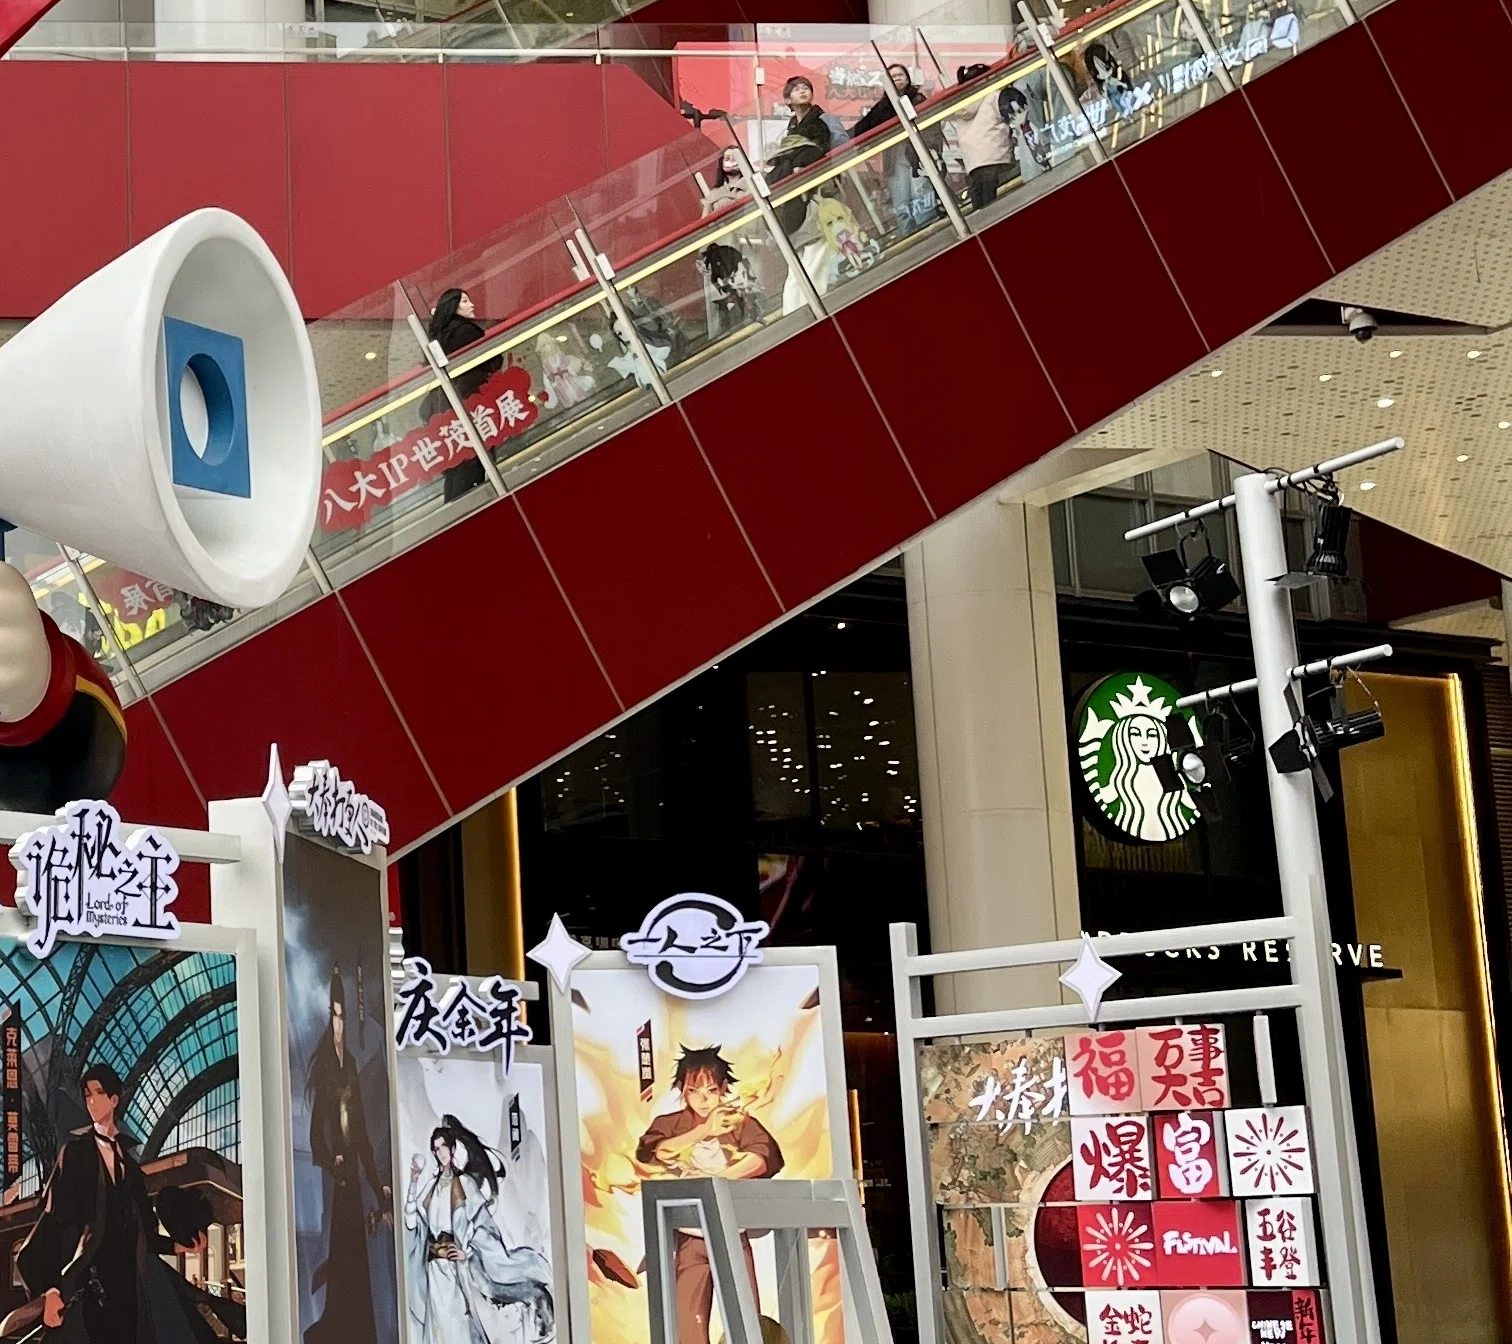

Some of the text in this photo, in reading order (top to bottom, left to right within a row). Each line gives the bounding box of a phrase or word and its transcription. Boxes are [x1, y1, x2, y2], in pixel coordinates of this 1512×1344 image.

[322, 389, 530, 525] 八大IP世茂首展
[85, 911, 128, 928] Mysteries
[86, 892, 129, 915] Lord of
[626, 924, 765, 955] 一人之下
[1242, 939, 1385, 969] RERVE
[396, 962, 530, 1076] 庆余年
[1072, 1030, 1136, 1100] 福
[1080, 1112, 1214, 1198] 爆 富
